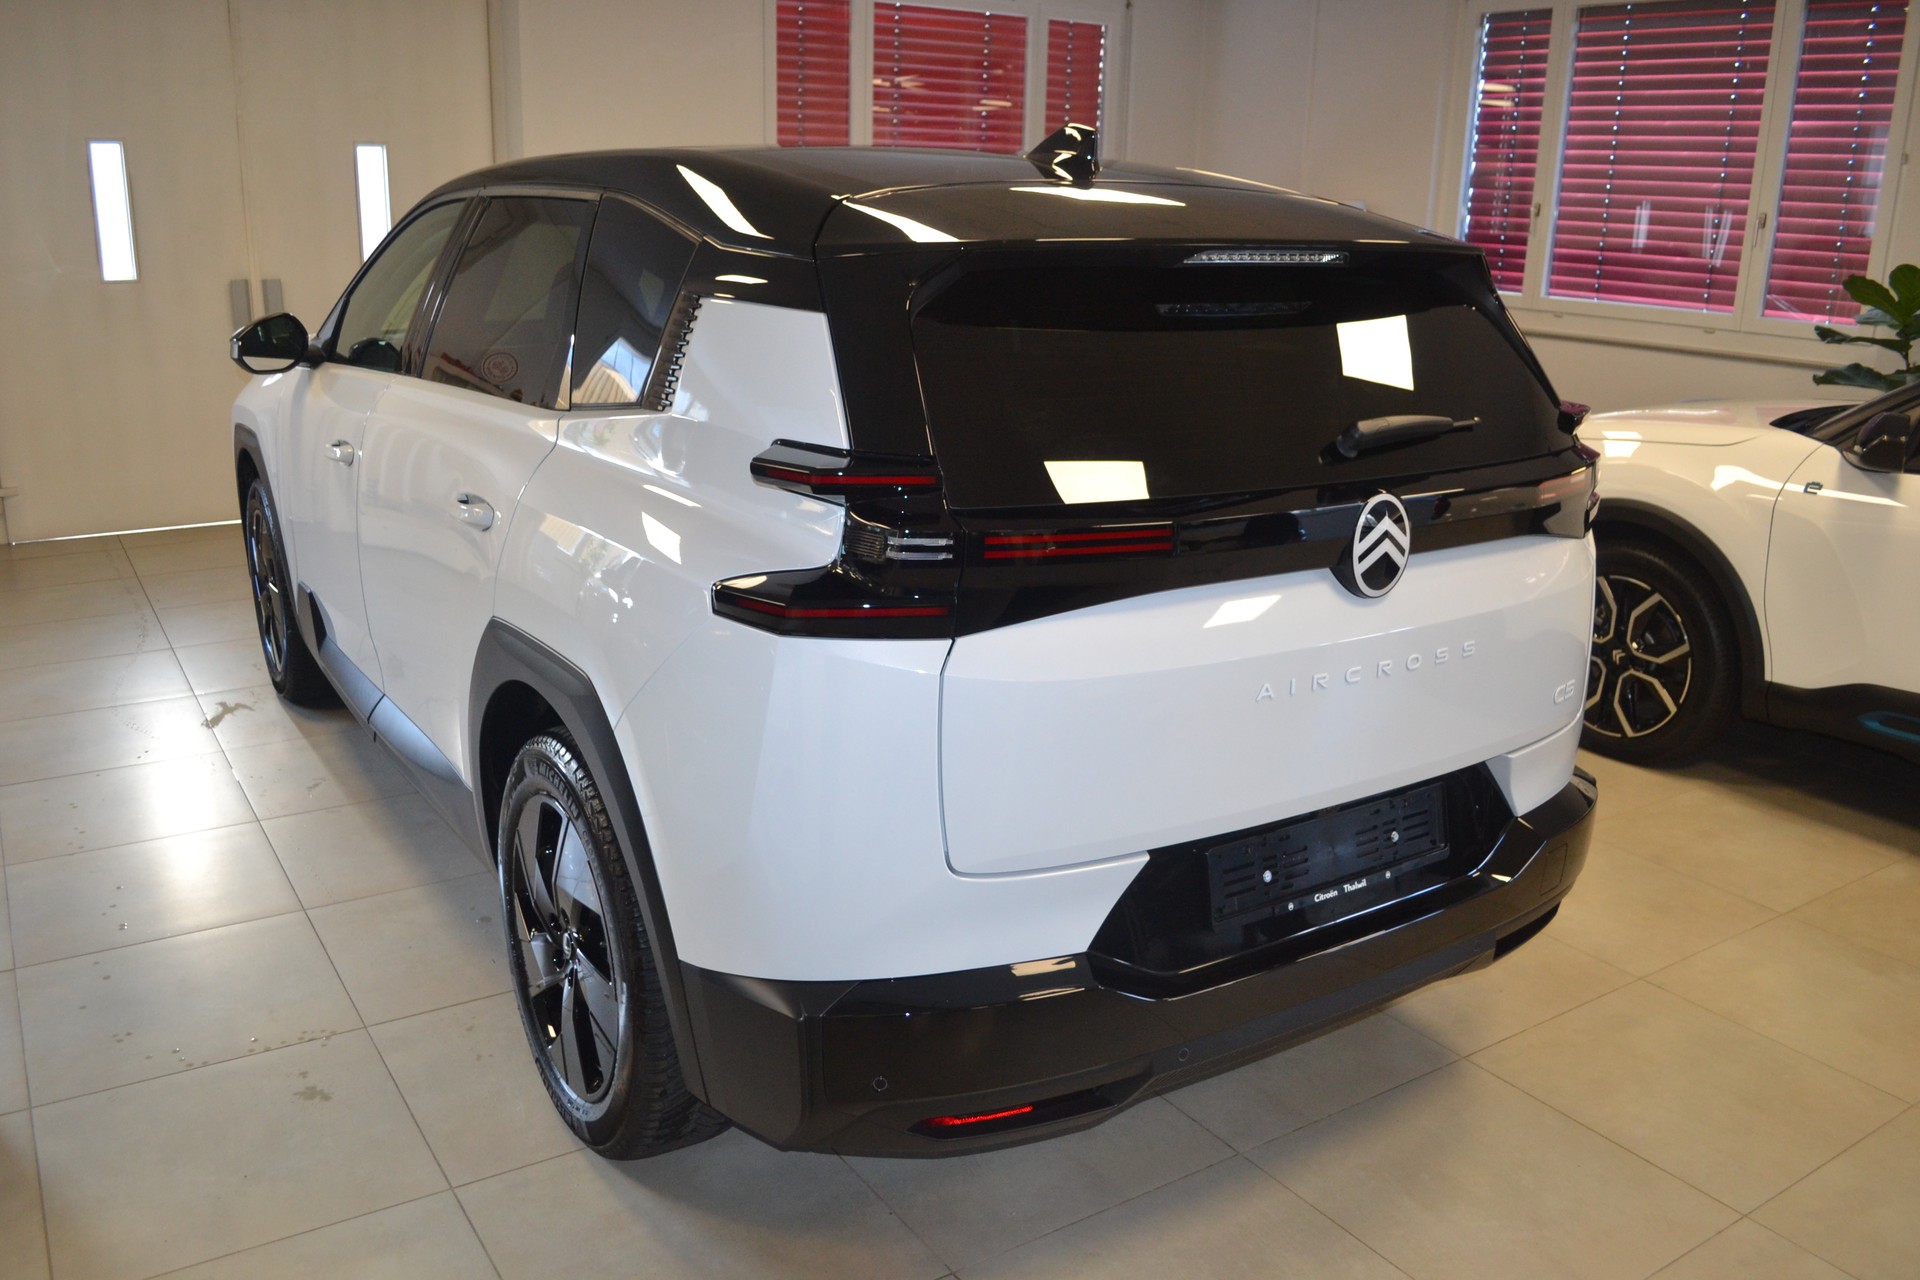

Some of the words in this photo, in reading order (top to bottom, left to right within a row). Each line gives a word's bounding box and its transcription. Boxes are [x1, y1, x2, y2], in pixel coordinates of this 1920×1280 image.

[1256, 640, 1476, 701] AIRCROSS
[1553, 679, 1575, 704] C5
[537, 761, 581, 820] MICHELIN
[1314, 890, 1338, 902] Citroën
[1343, 878, 1367, 893] Thalwil
